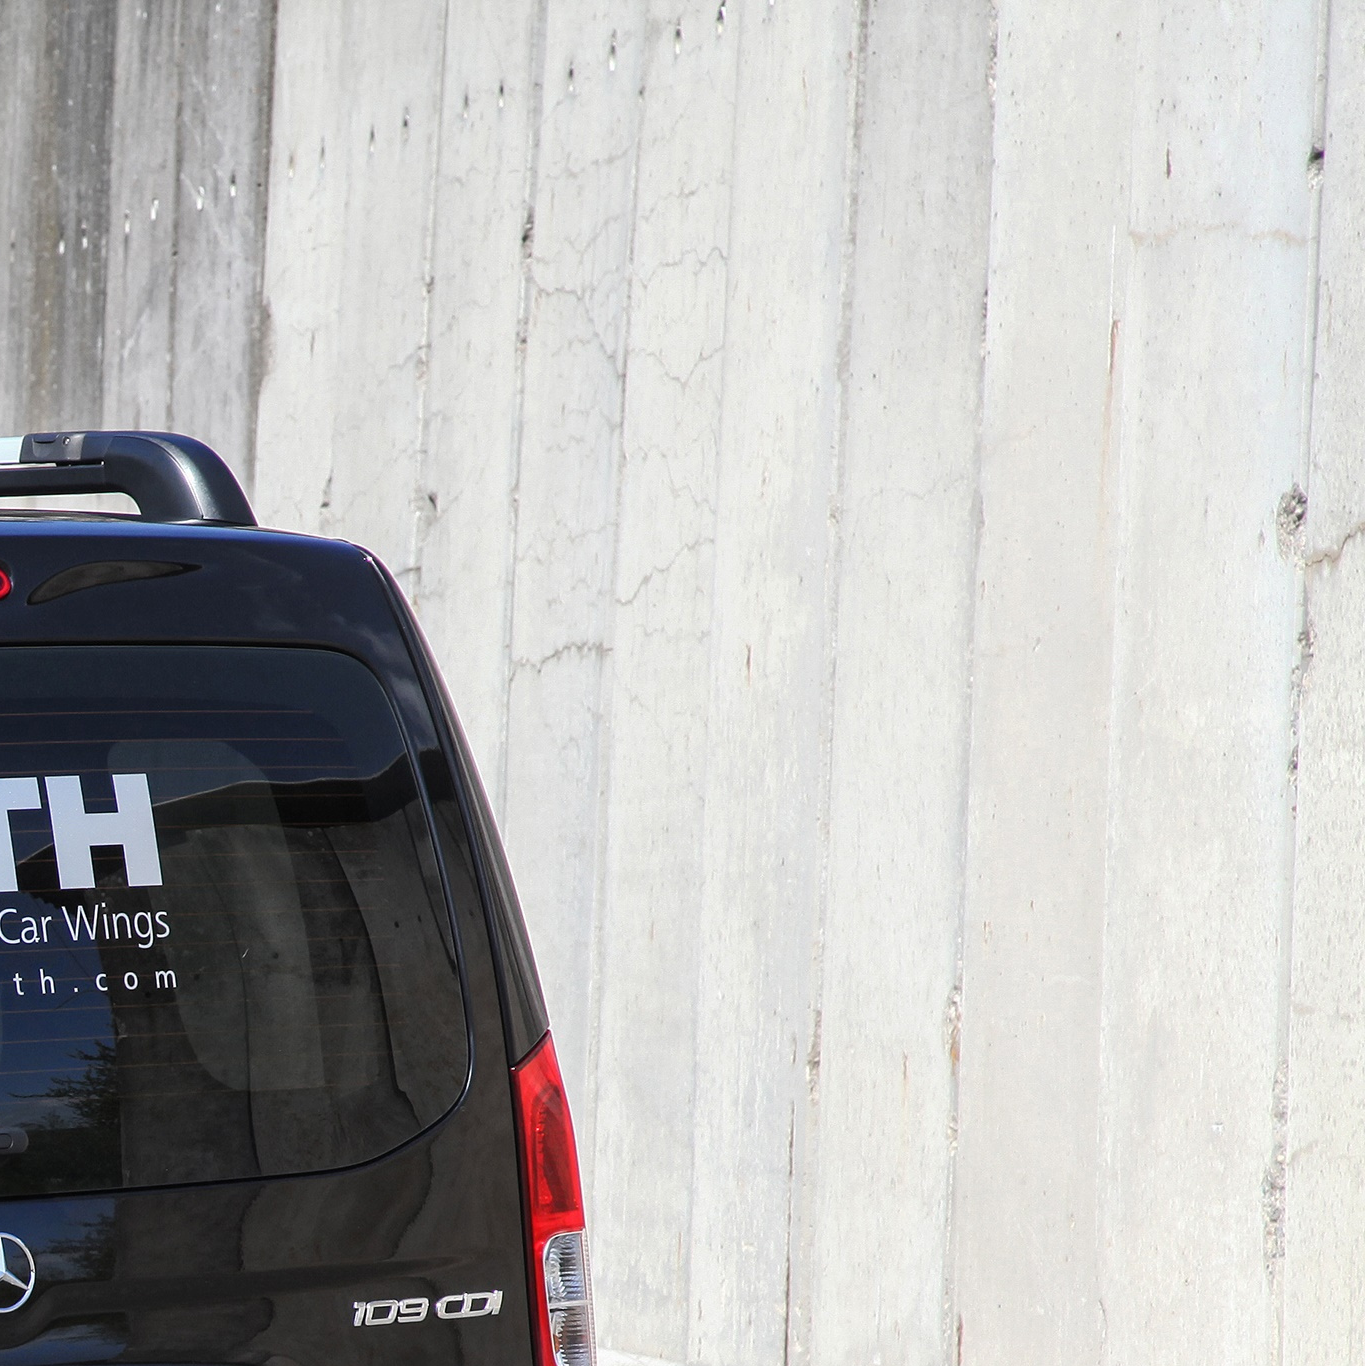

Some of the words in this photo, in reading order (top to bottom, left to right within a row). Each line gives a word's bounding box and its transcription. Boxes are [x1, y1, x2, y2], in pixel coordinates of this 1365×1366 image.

[61, 902, 171, 949] Wings
[352, 1297, 430, 1327] 109
[435, 1289, 504, 1320] CDI
